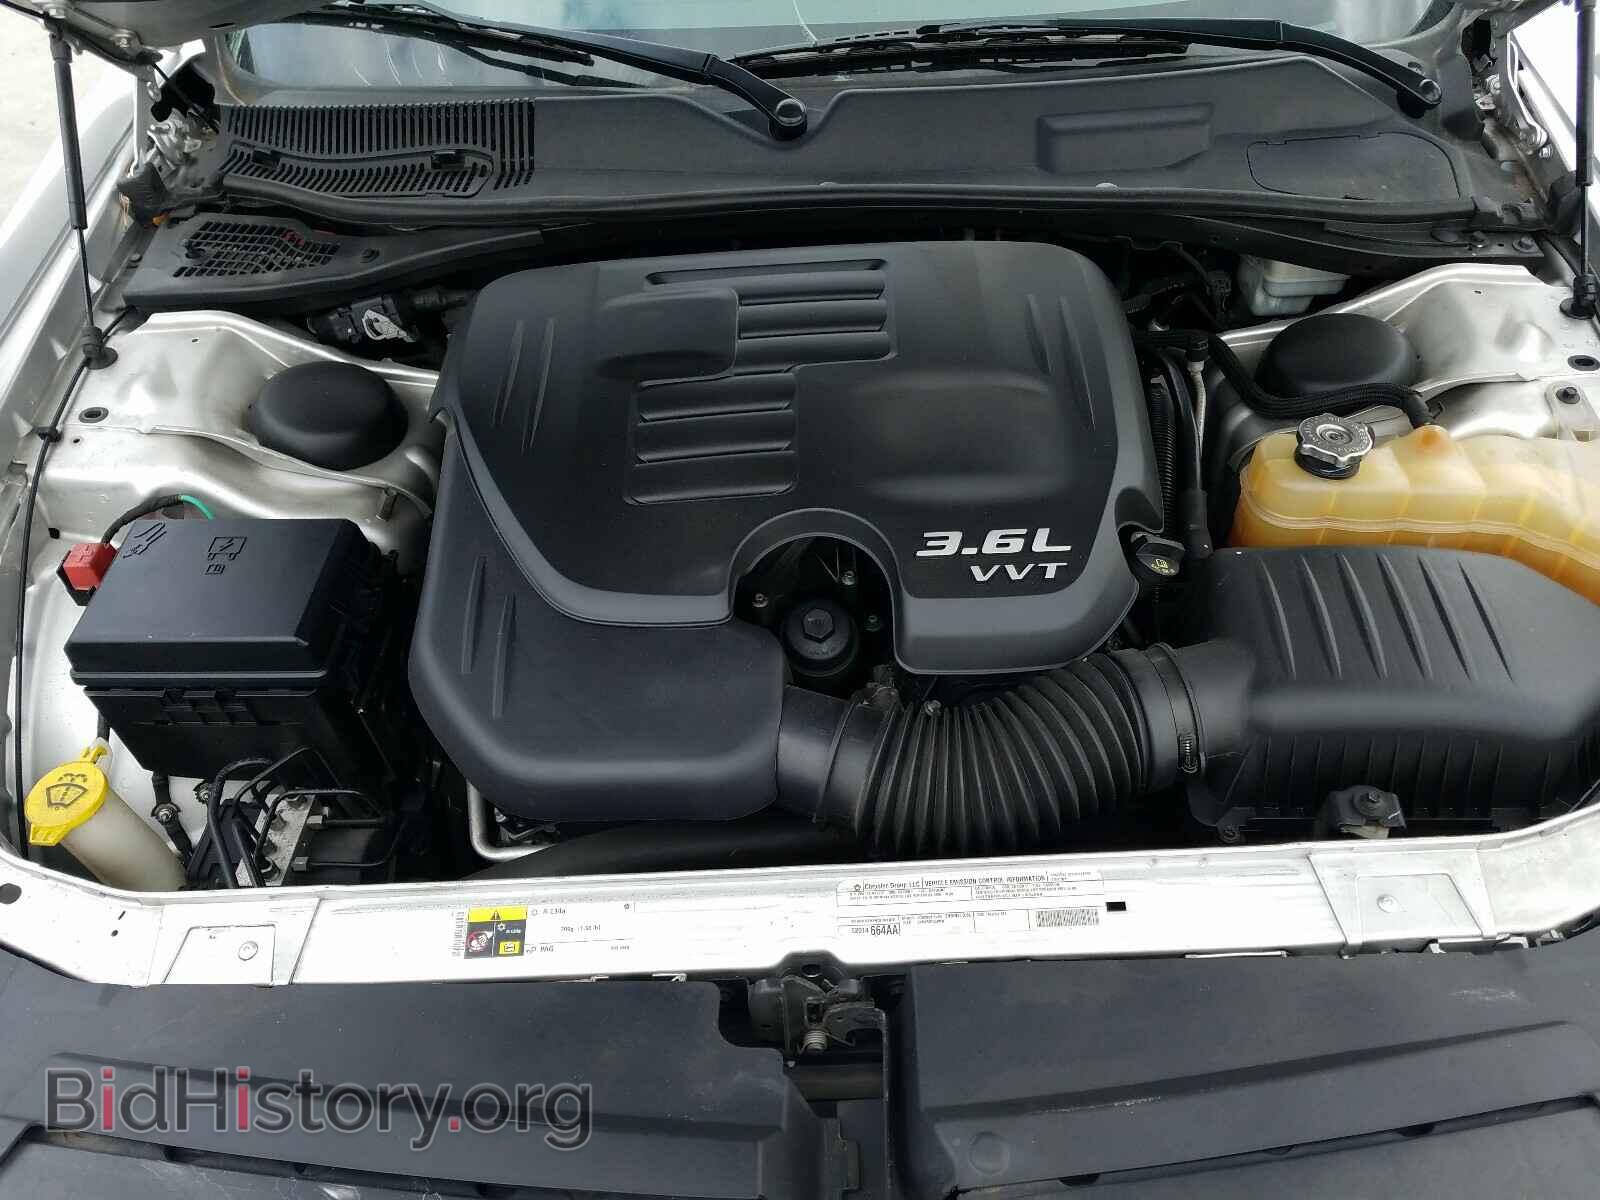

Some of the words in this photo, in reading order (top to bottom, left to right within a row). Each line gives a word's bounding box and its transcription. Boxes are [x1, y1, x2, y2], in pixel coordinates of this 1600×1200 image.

[916, 527, 1072, 557] 3.6L
[970, 562, 1068, 582] VVT
[924, 879, 948, 888] VEHICLE
[949, 878, 977, 886] EMISSION
[978, 876, 1003, 885] CONTROL
[1006, 874, 1046, 883] INFORMATION
[870, 924, 898, 936] 664AA
